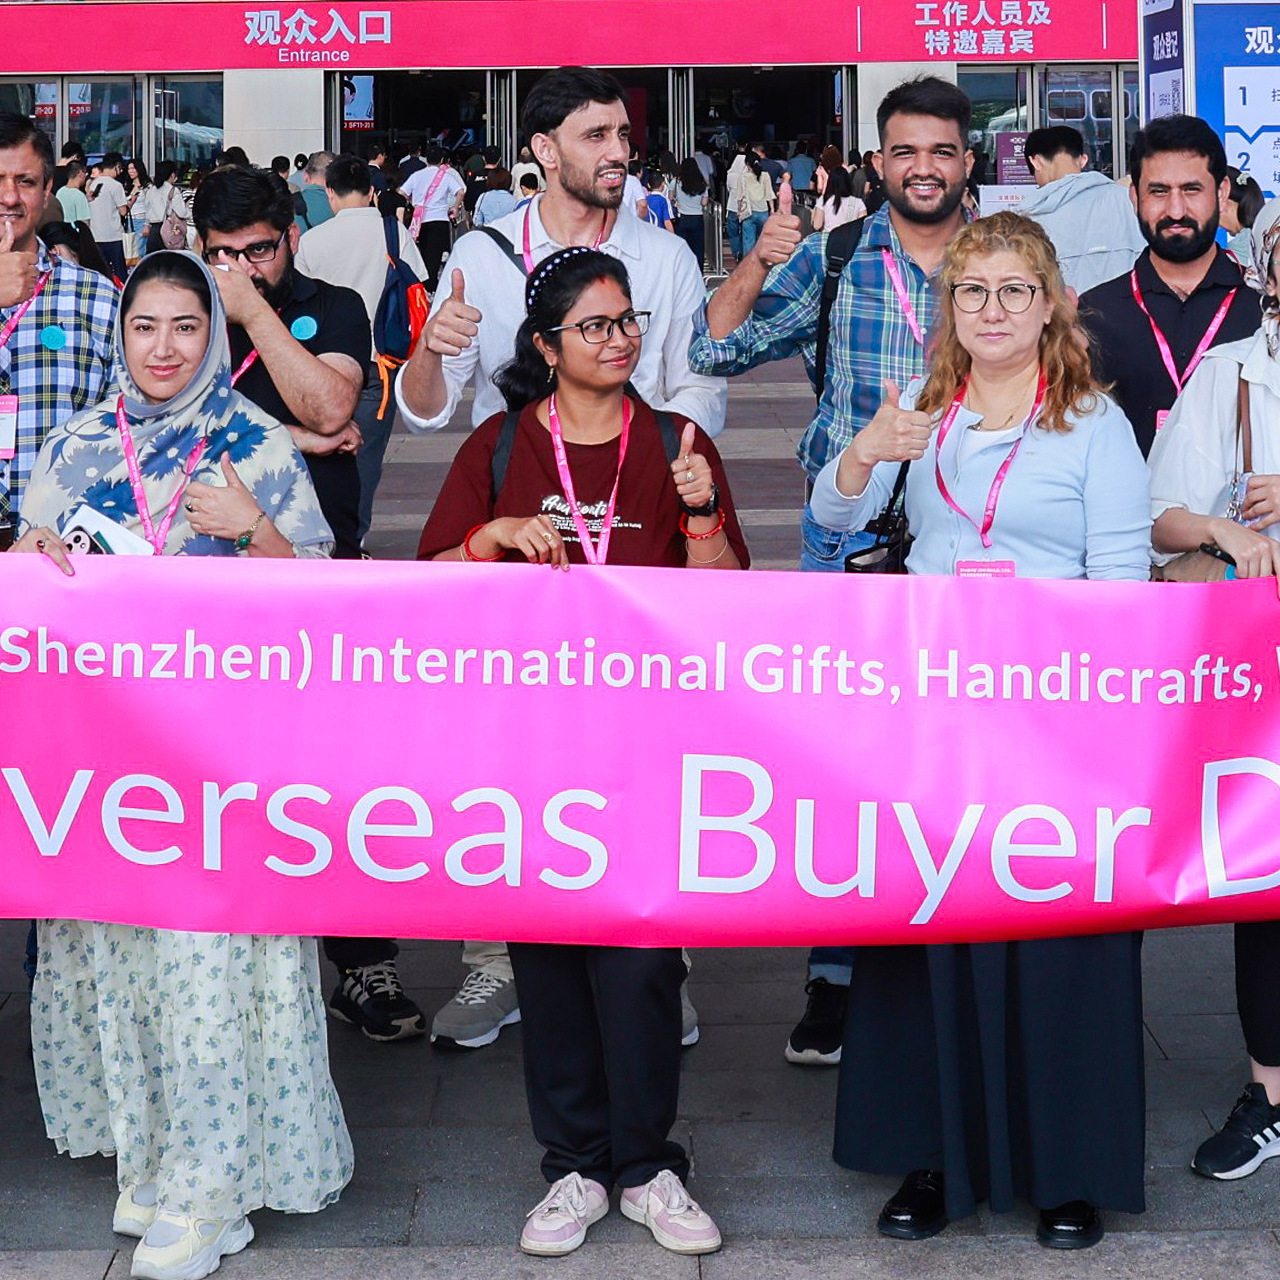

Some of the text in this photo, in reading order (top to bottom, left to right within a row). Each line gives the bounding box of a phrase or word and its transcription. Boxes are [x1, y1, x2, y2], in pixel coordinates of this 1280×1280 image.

[914, 0, 1052, 26] 工作人员及
[244, 8, 392, 46] 观众入口
[278, 48, 350, 62] Entrance
[924, 29, 1035, 55] 特邀嘉宾
[1239, 86, 1247, 106] 1
[1237, 152, 1251, 171] 2
[331, 632, 726, 693] International
[743, 642, 900, 706] Gifts,
[917, 648, 1263, 706] Handicrafts,
[677, 753, 1152, 925] Buyer
